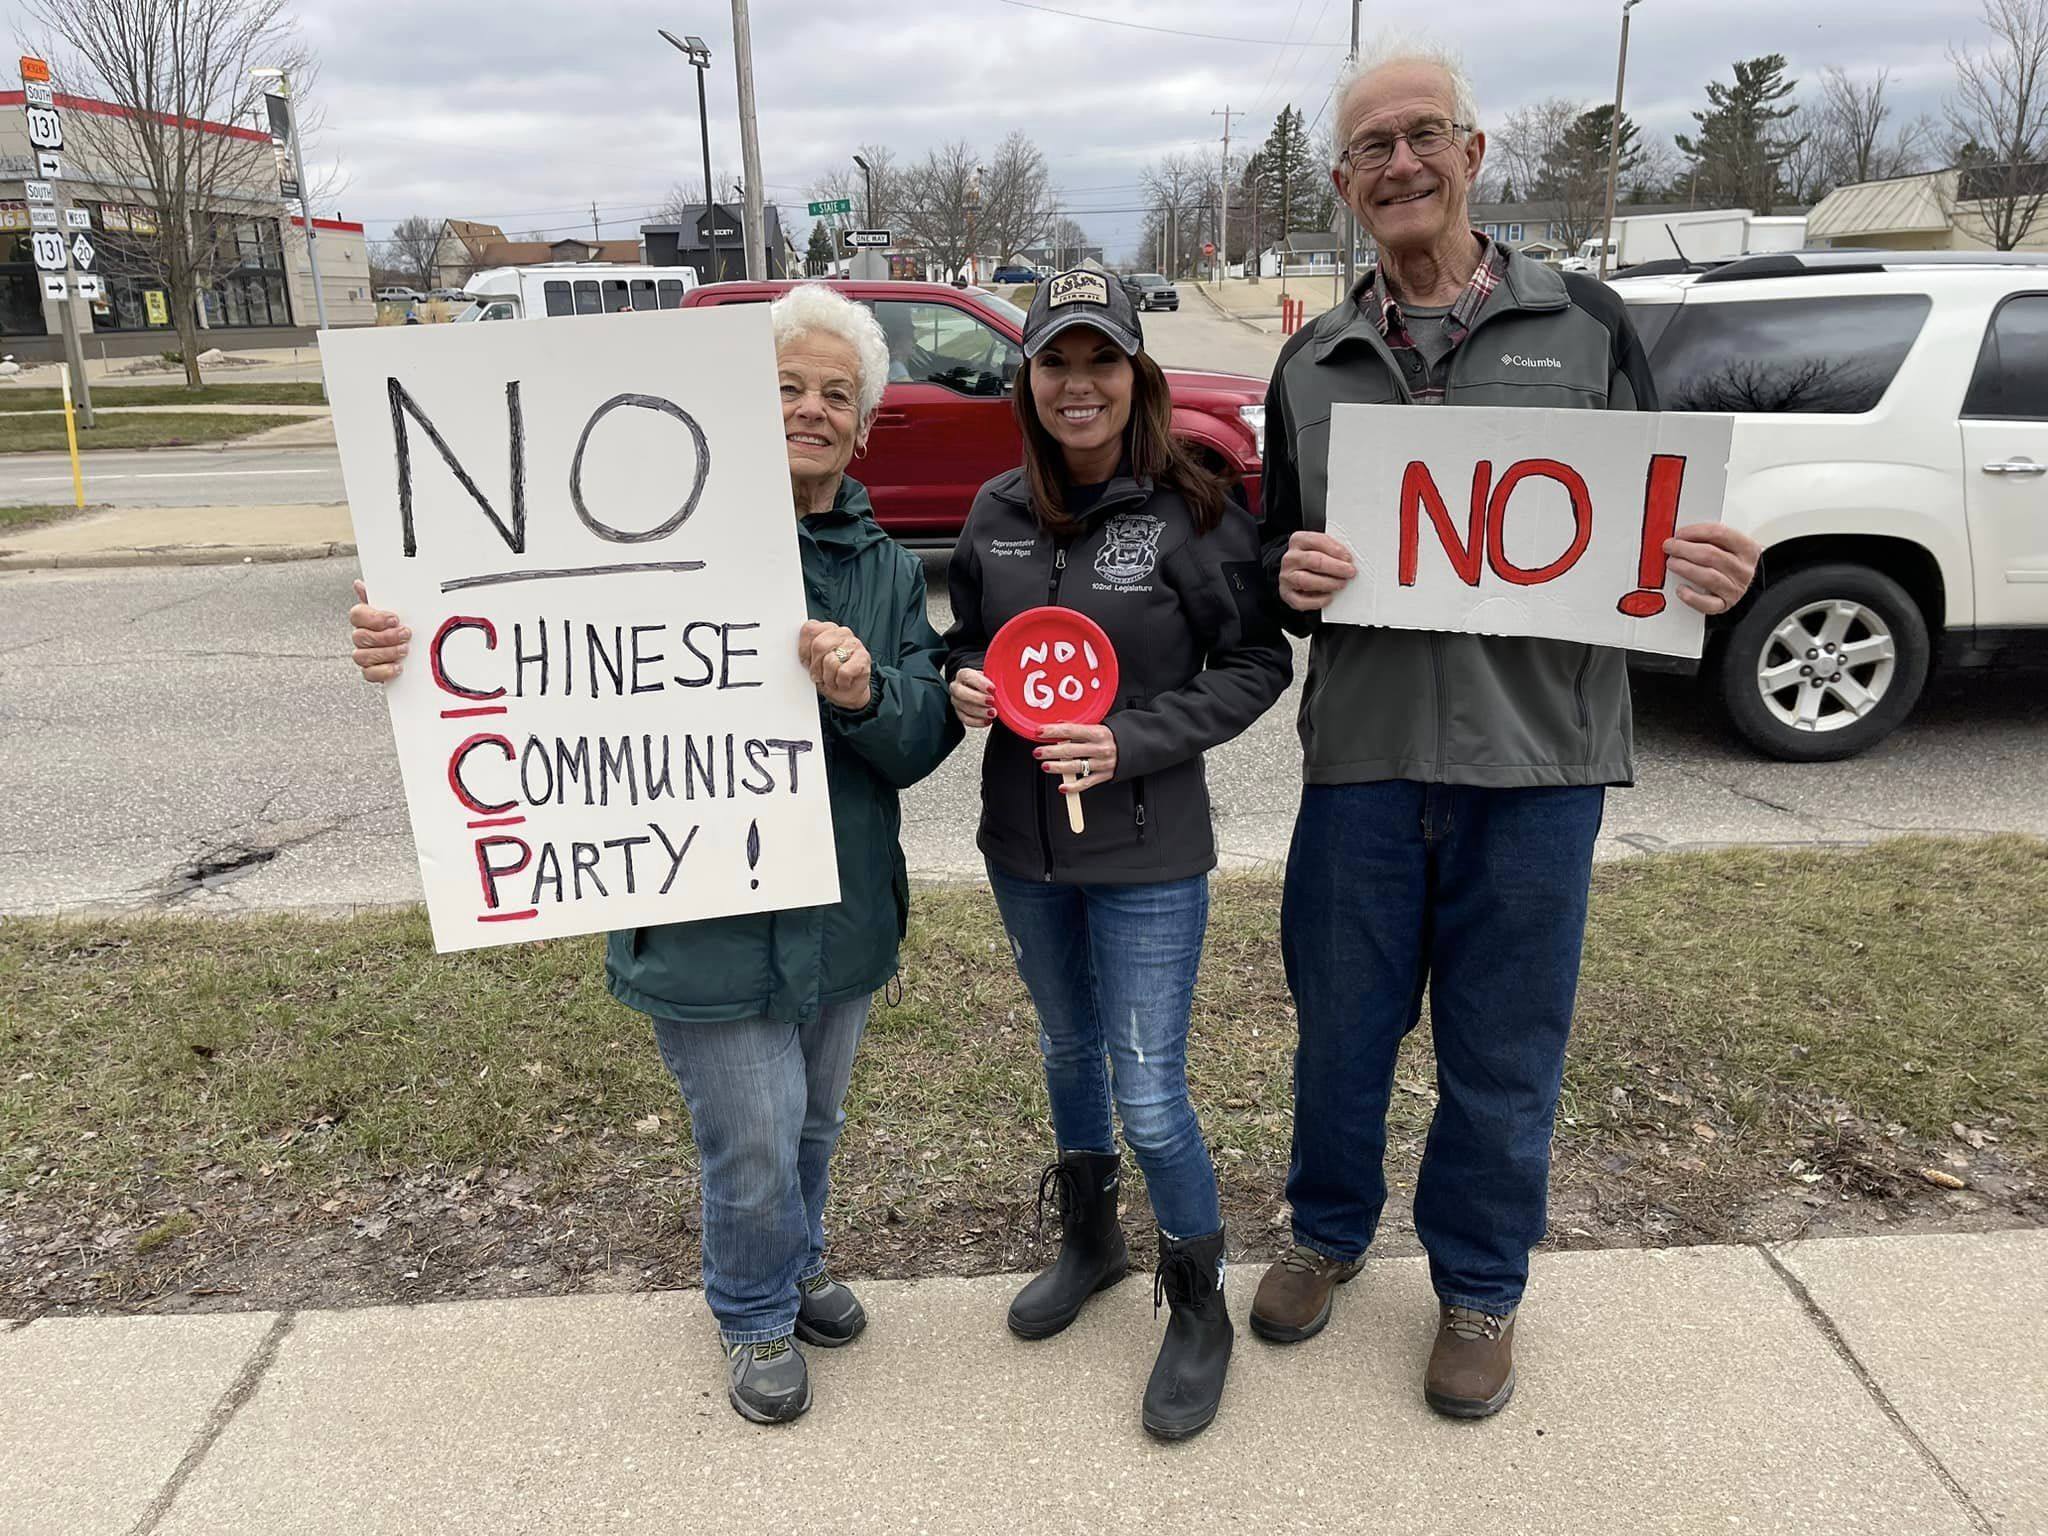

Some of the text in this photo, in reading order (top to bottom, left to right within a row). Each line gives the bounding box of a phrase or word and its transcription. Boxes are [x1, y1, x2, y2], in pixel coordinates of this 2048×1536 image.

[28, 85, 50, 102] SOUTH
[33, 115, 57, 139] 131
[28, 184, 52, 199] SOUTH
[818, 201, 839, 214] STATE
[67, 212, 87, 225] WEST
[856, 234, 886, 242] ONE WAY
[38, 240, 62, 261] 131
[77, 247, 91, 261] 20
[1512, 355, 1561, 368] Columbia
[386, 377, 711, 558] NO
[992, 539, 1035, 548] Representative
[1092, 582, 1153, 593] 102nd Legislature
[430, 615, 764, 700] CHINESE
[448, 732, 814, 816] COMMUNIST
